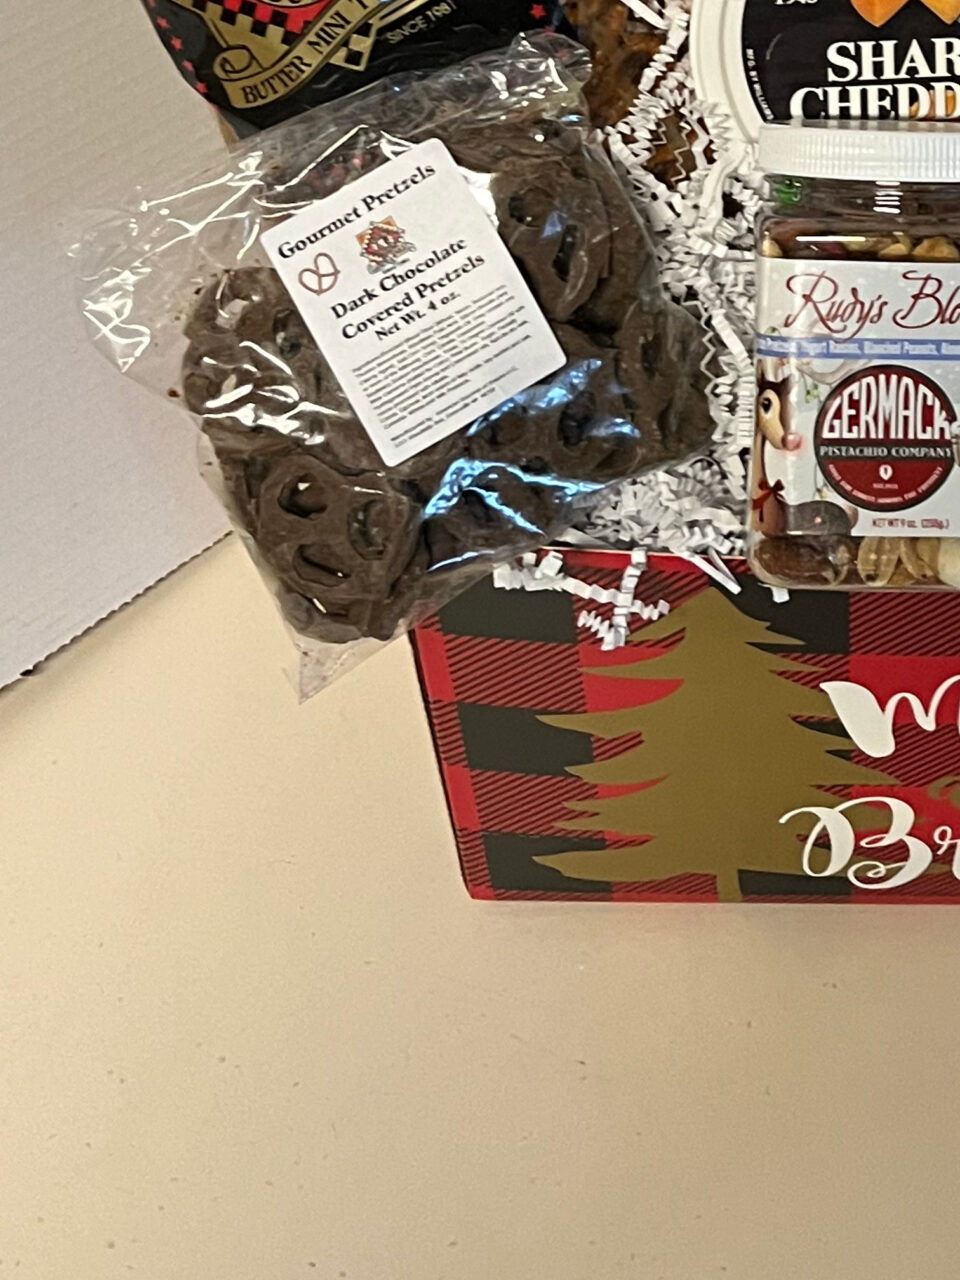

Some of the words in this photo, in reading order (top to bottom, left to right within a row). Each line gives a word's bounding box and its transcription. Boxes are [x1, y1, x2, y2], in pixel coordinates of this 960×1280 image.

[241, 56, 312, 104] BUTTER
[308, 11, 351, 55] MINI
[386, 14, 428, 44] SINCE
[426, 0, 456, 22] 1981
[278, 206, 361, 259] Gourmet
[361, 162, 436, 212] Pretzels
[331, 282, 379, 320] Dark
[379, 238, 468, 293] Chocolate
[341, 293, 414, 340] Covered
[415, 254, 485, 301] Pretzels
[784, 271, 888, 344] Rudy's
[375, 322, 400, 340] Net
[428, 300, 438, 311] 4
[822, 374, 951, 440] GERMACK
[820, 446, 888, 457] PISTACHIO
[891, 446, 952, 457] COMPANY
